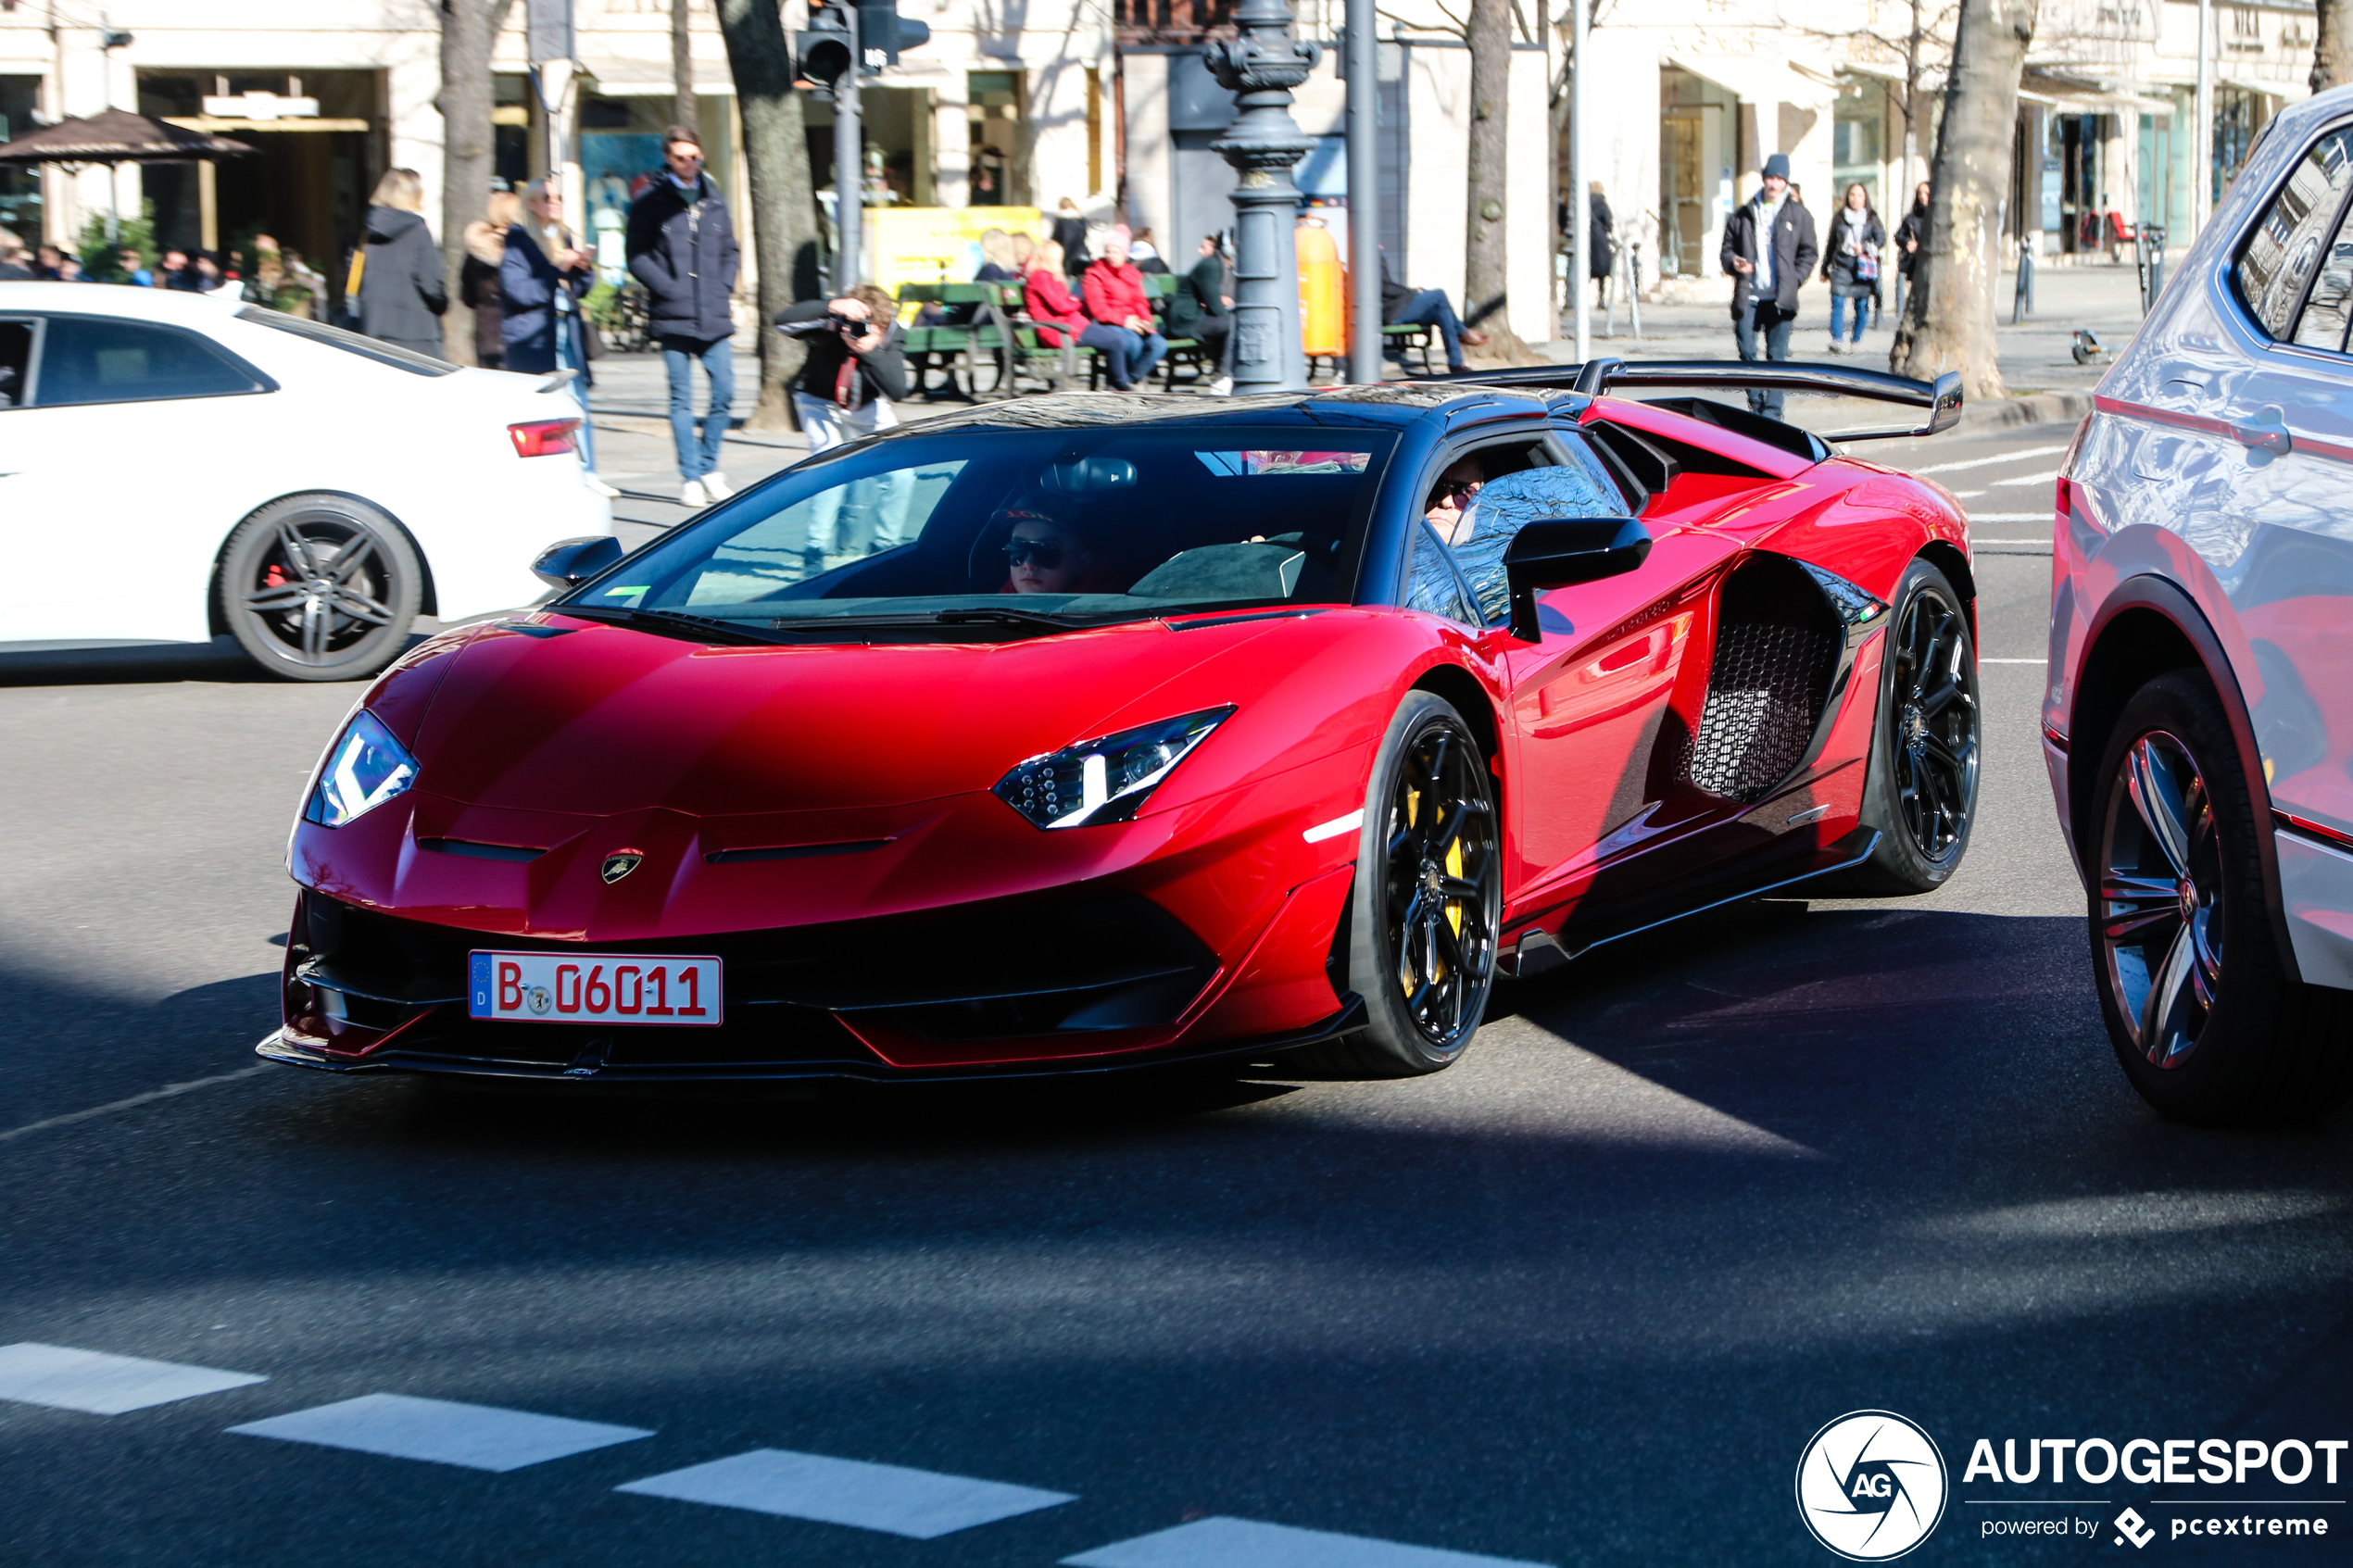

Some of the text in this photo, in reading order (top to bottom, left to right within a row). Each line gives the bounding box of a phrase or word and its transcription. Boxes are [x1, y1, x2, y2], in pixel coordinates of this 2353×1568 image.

[477, 992, 485, 1006] D
[499, 962, 706, 1016] B 06011
